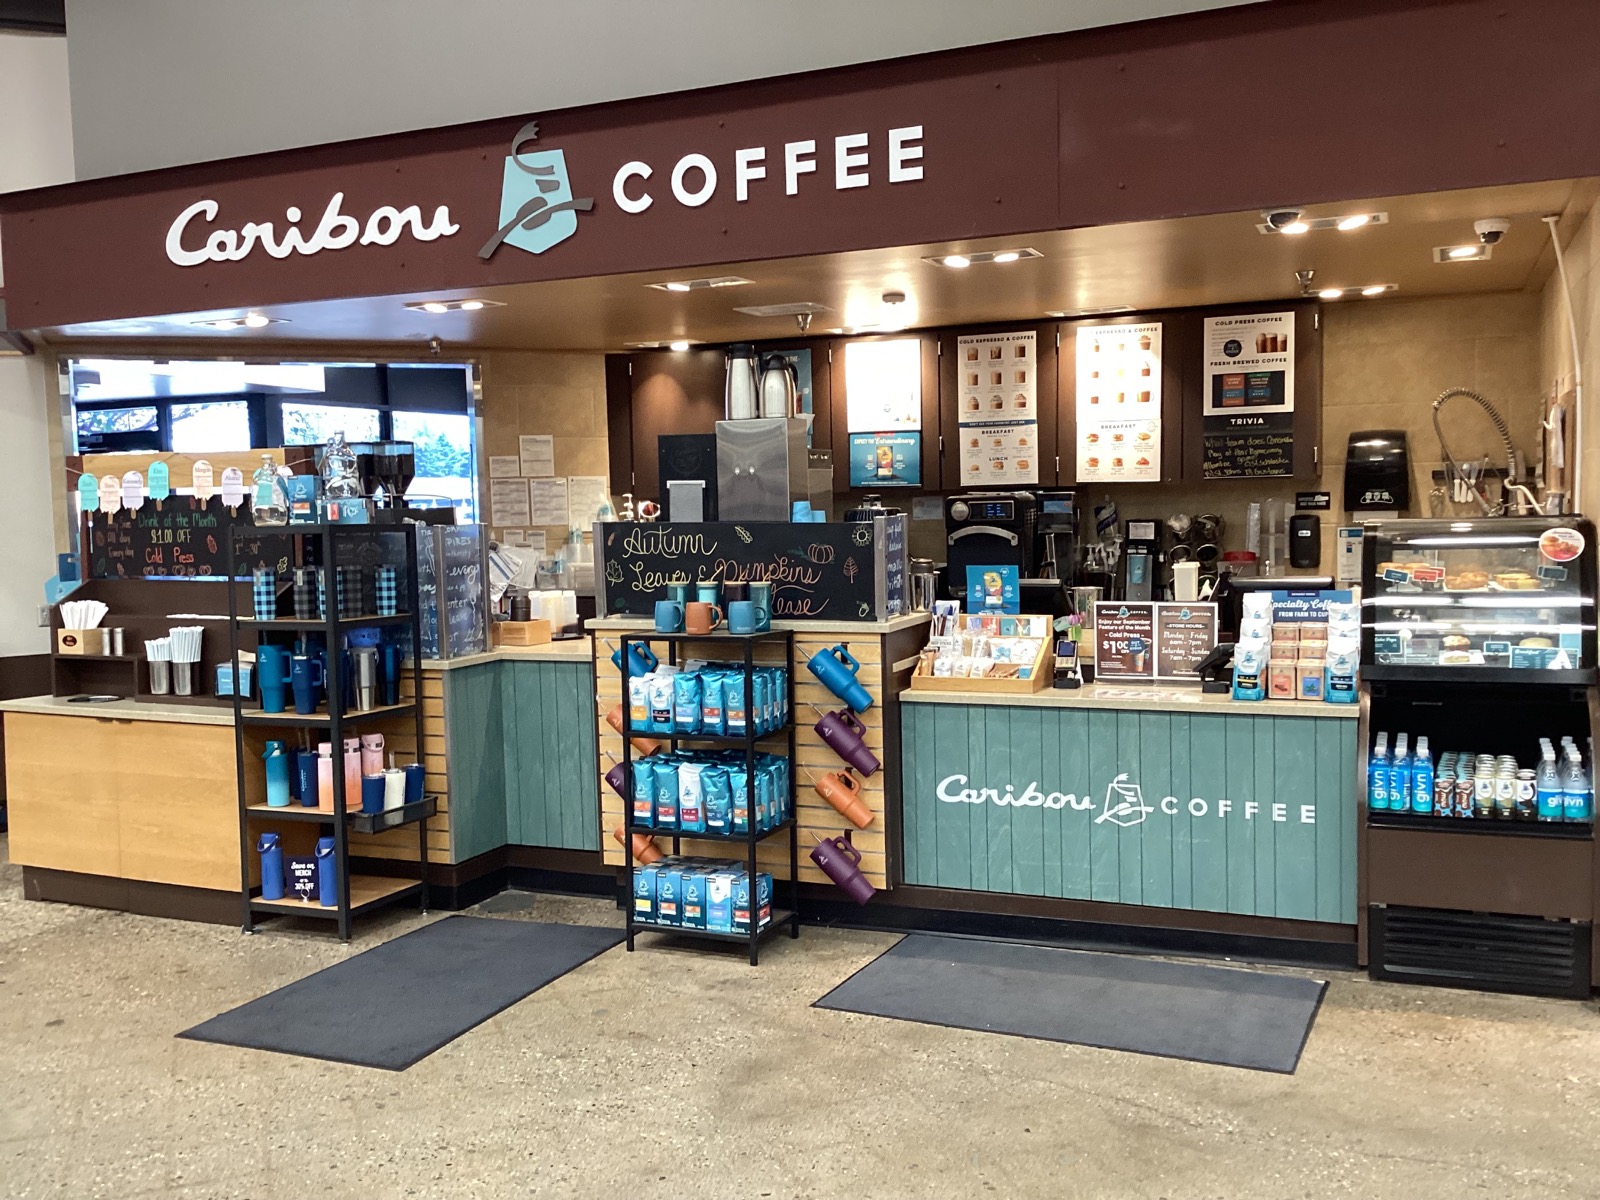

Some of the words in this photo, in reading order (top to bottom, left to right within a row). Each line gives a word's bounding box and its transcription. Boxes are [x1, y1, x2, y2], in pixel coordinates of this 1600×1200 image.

[166, 192, 459, 266] Caribou
[612, 125, 924, 213] COFFEE
[1256, 316, 1283, 324] COFFEE
[1230, 417, 1264, 425] TRIVIA
[138, 514, 158, 528] Drink
[163, 514, 172, 528] of
[176, 511, 189, 528] the
[193, 512, 217, 528] Month
[177, 528, 191, 544] OFF
[623, 526, 717, 559] Autumn
[145, 546, 163, 564] Cold
[173, 546, 194, 564] Press
[629, 561, 691, 593] Leaves
[714, 554, 821, 595] Pumpkins
[1271, 600, 1310, 611] pecialty
[1163, 632, 1185, 640] Monday
[1190, 632, 1208, 641] Friday
[1162, 647, 1185, 656] Saturday
[1372, 770, 1387, 799] givn
[1414, 773, 1430, 803] givn
[936, 774, 1096, 811] Caribou
[1161, 796, 1316, 824] COFFEE
